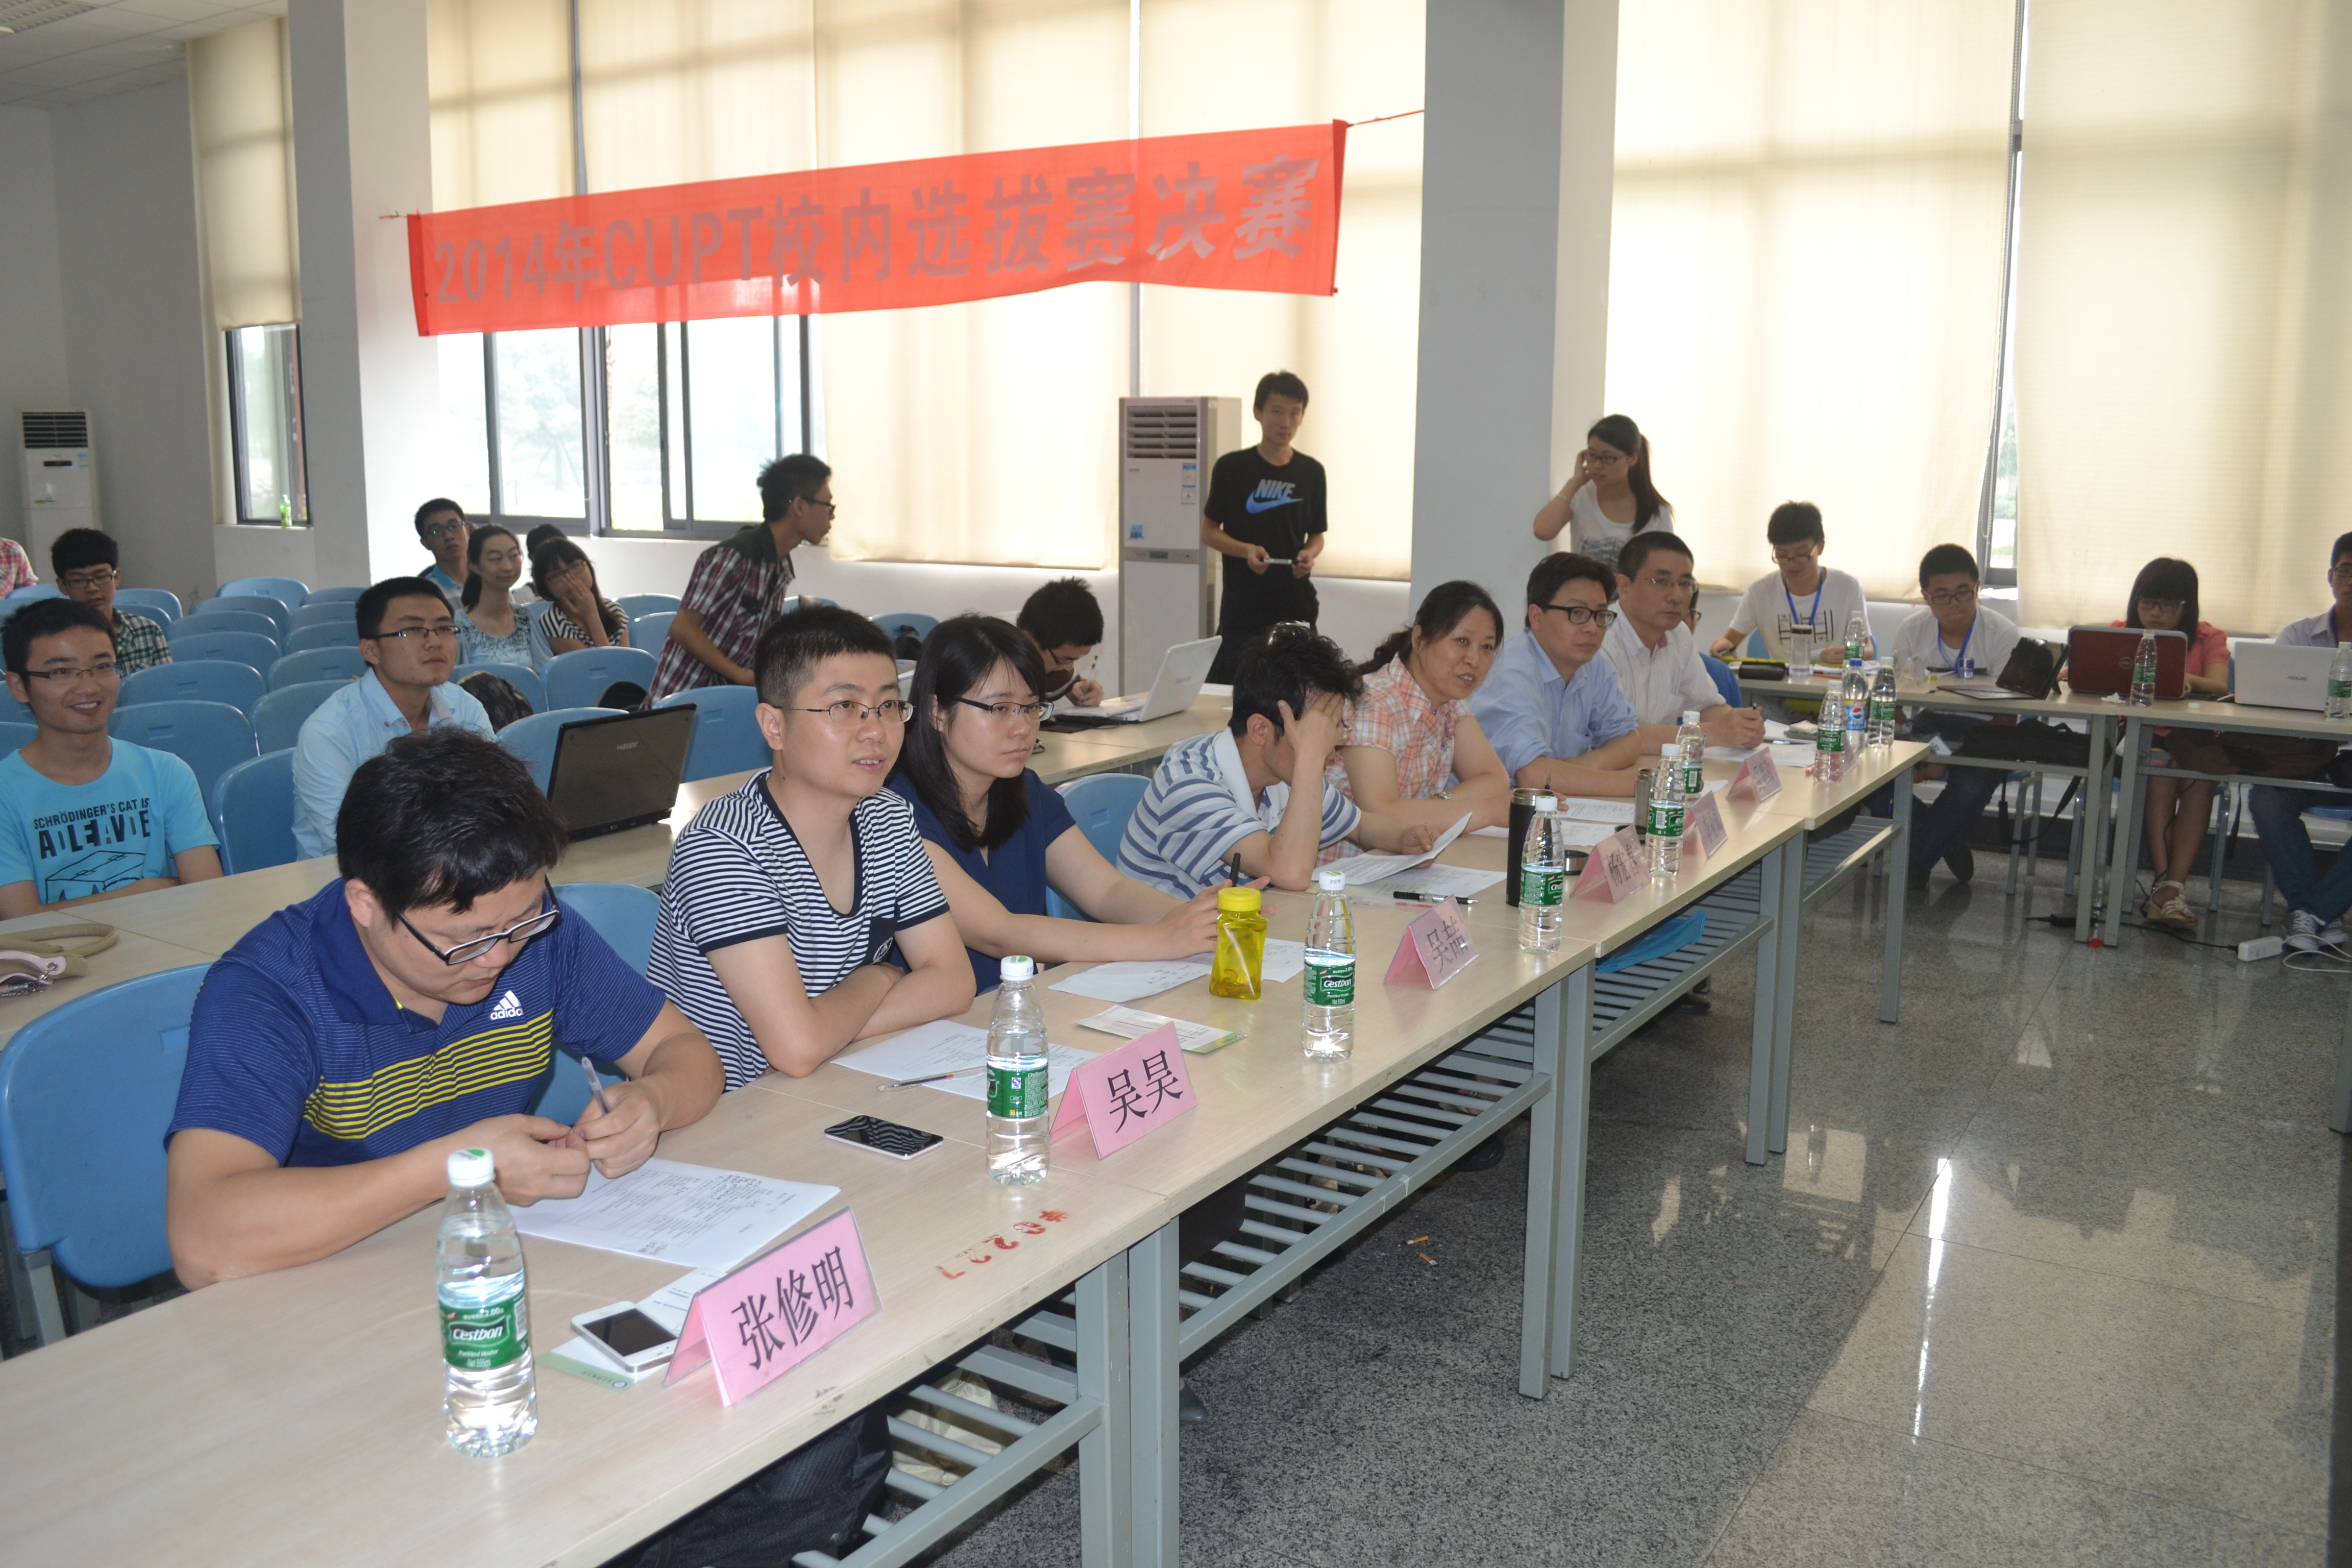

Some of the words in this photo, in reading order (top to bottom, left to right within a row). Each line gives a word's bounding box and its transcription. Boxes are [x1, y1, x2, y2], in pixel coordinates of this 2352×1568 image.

[434, 153, 1320, 305] 2014年CUPT校内选拔赛决赛
[1255, 479, 1295, 500] NIKE
[119, 799, 137, 812] CAT
[141, 797, 150, 807] IS
[1427, 916, 1468, 973] 吴喆
[491, 1007, 523, 1020] adida
[1107, 1049, 1183, 1134] 吴昊
[731, 1245, 854, 1370] 张修明
